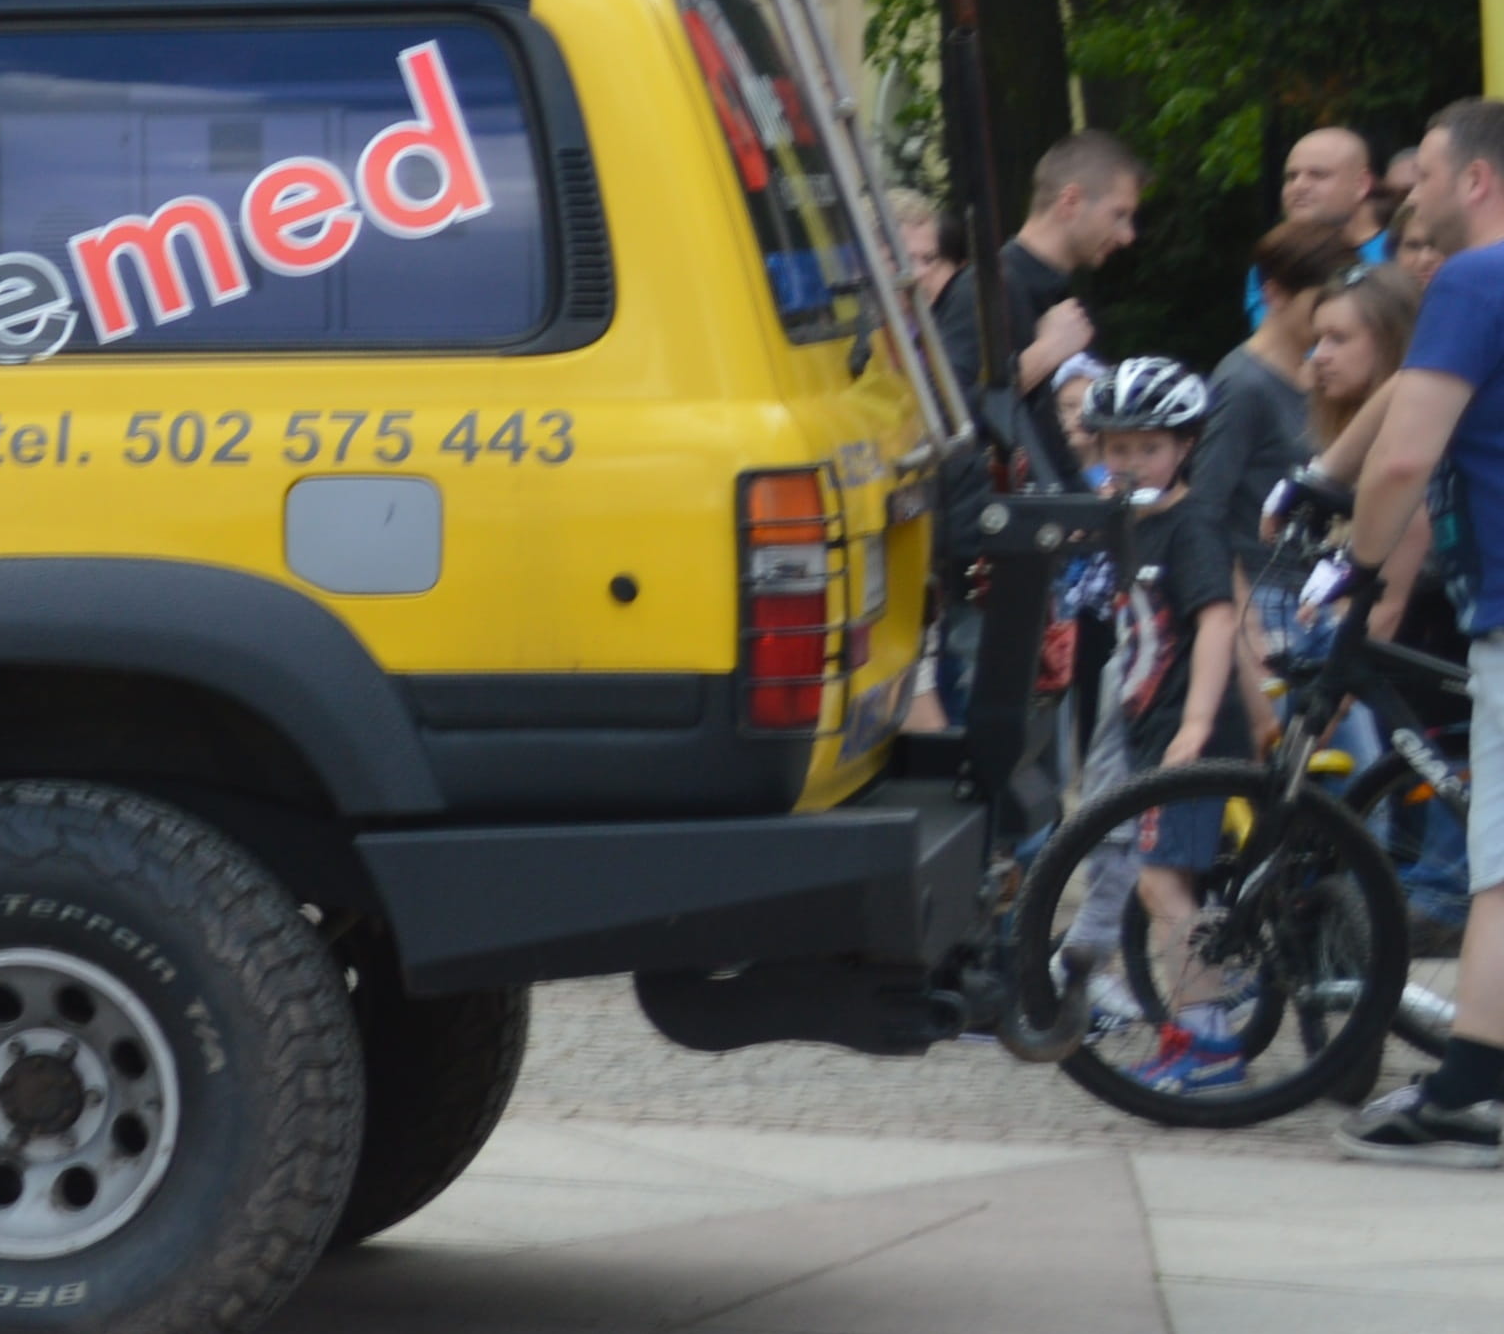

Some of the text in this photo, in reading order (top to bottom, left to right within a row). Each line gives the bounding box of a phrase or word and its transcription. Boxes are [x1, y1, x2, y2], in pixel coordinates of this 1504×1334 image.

[122, 410, 254, 465] 502
[283, 410, 414, 465] 575
[439, 409, 575, 465] 443
